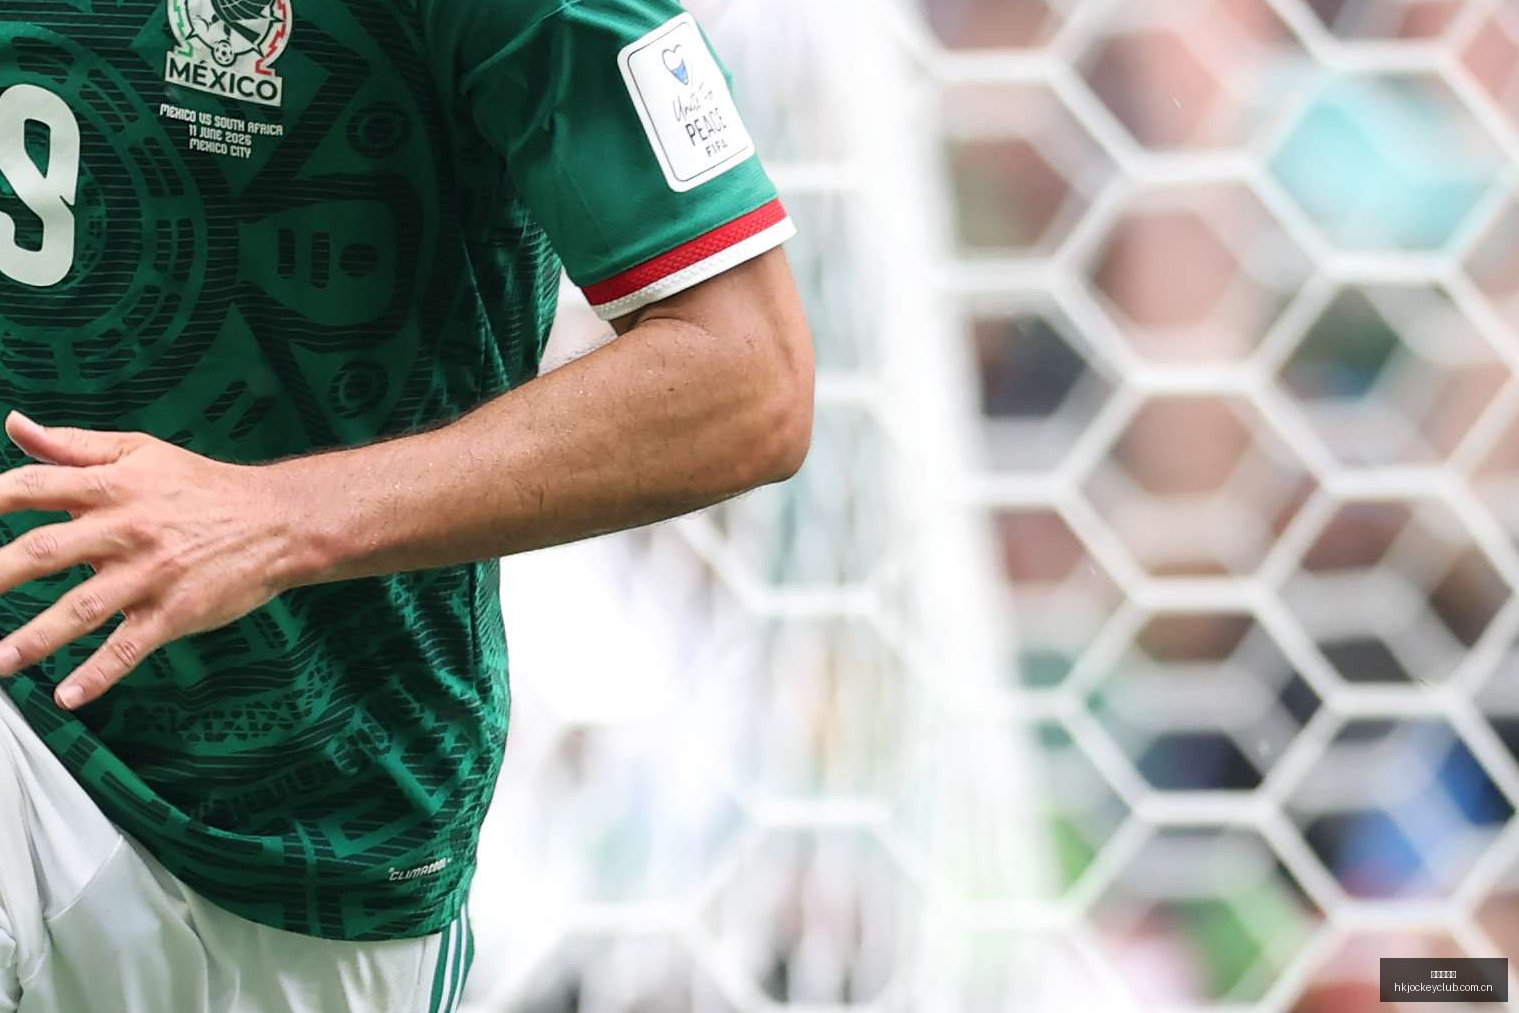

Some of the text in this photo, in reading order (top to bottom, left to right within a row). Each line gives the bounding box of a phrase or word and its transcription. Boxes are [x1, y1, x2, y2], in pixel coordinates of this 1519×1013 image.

[169, 57, 278, 101] MÉXICO
[160, 103, 196, 122] MEXICO
[214, 115, 245, 131] SOUTH
[247, 121, 283, 136] AFRICA
[189, 124, 252, 146] 11 JUNE 2026
[189, 138, 252, 158] MEXICO CITY
